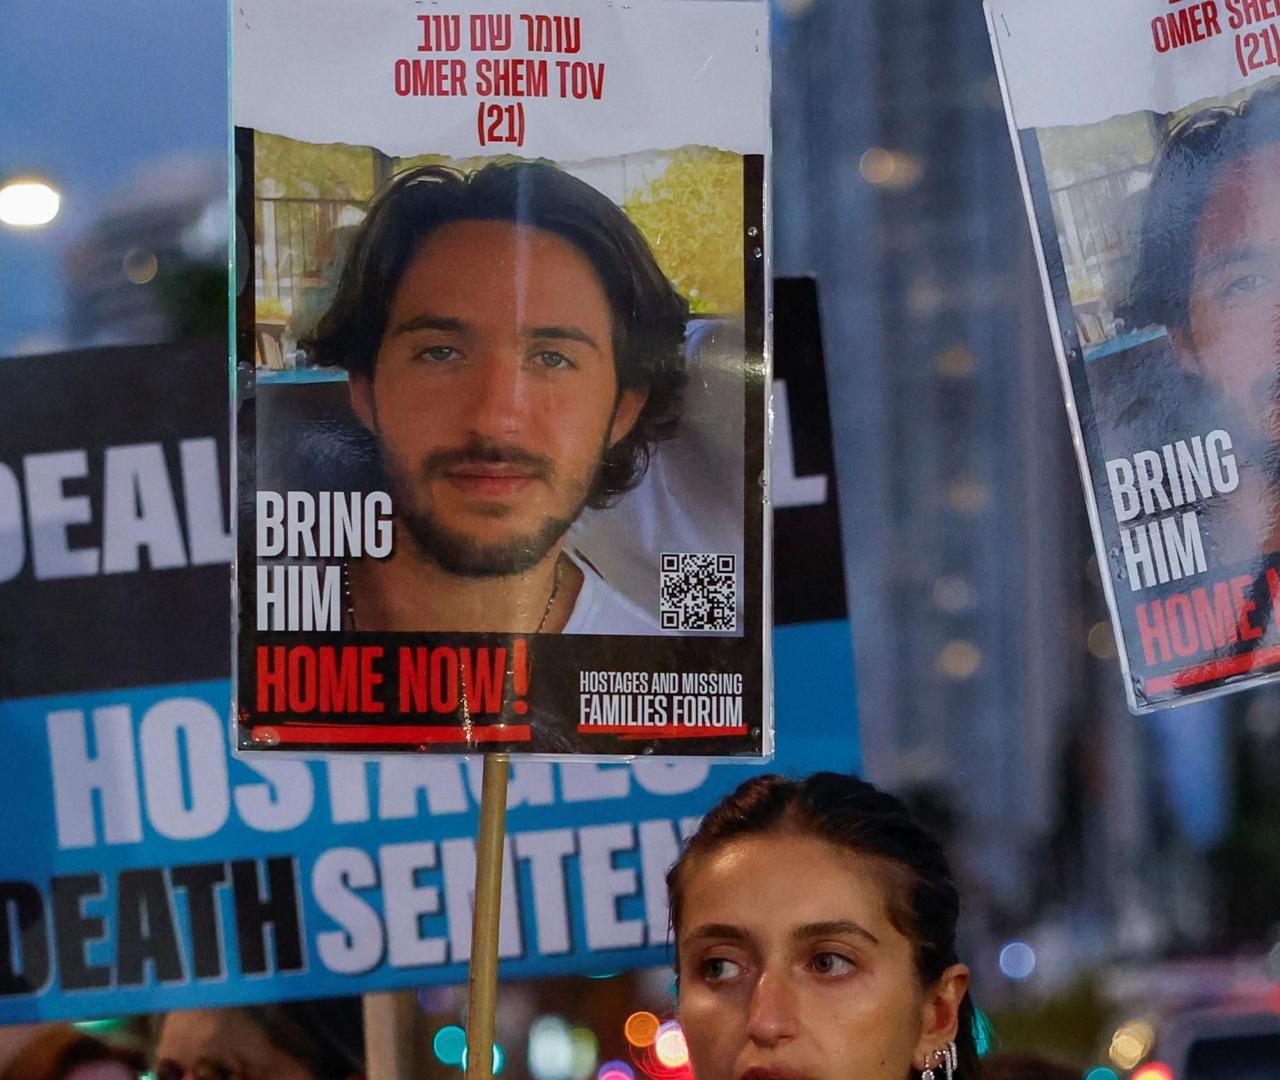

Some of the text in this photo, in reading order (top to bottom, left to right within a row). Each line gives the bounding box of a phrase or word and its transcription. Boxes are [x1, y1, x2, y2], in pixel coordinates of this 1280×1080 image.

[417, 14, 581, 54] עומר שם טוב
[1151, 0, 1223, 53] OMER
[394, 59, 605, 100] OMER SHEM TOV
[477, 102, 525, 147] (21)
[1106, 429, 1239, 522] BRING
[256, 491, 393, 559] BRING
[1119, 511, 1207, 592] HIM
[257, 565, 341, 632] HIM
[1136, 574, 1265, 667] HOME
[257, 639, 530, 715] HOME NOW!
[579, 671, 743, 696] HOSTAGES AND MISSING
[579, 694, 744, 728] FAMILIES FORUM
